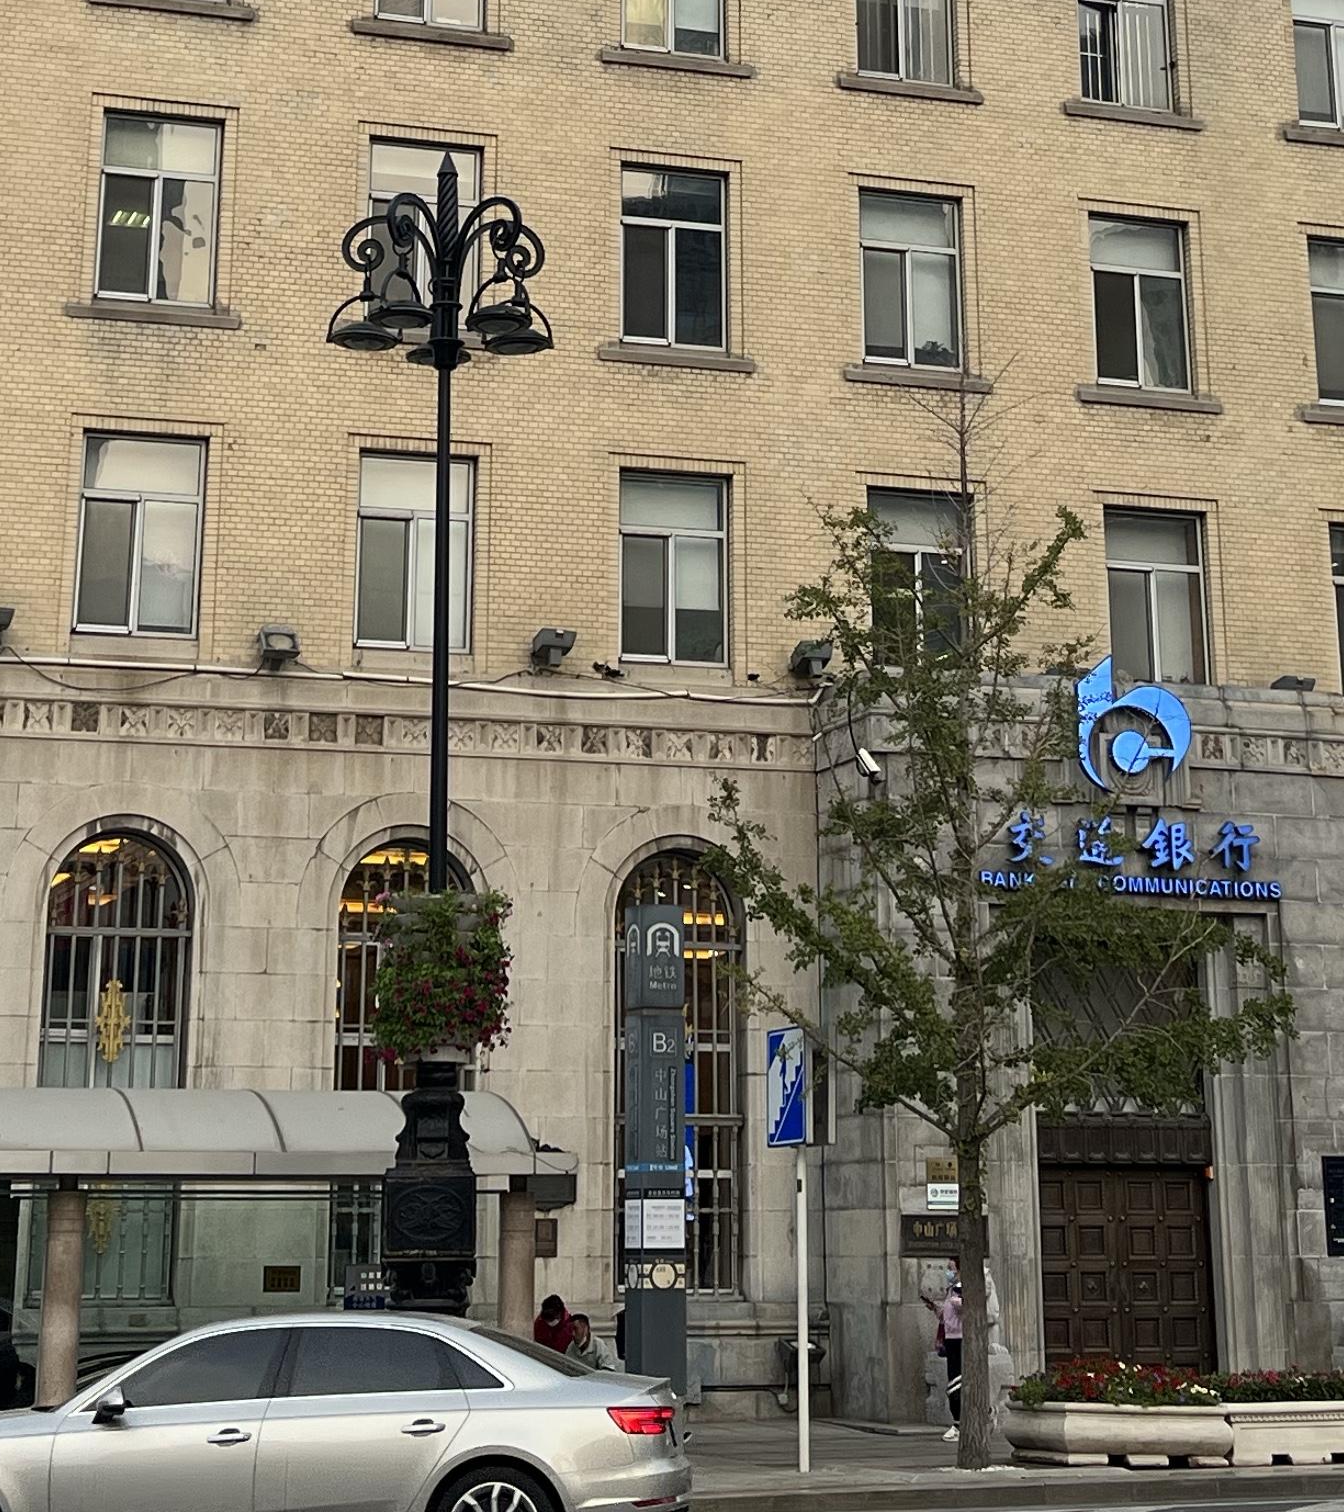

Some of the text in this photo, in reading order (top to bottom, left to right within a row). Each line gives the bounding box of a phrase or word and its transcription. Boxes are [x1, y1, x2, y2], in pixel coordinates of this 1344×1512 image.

[649, 964, 677, 979] 地铁
[655, 1067, 668, 1159] 中山广场站
